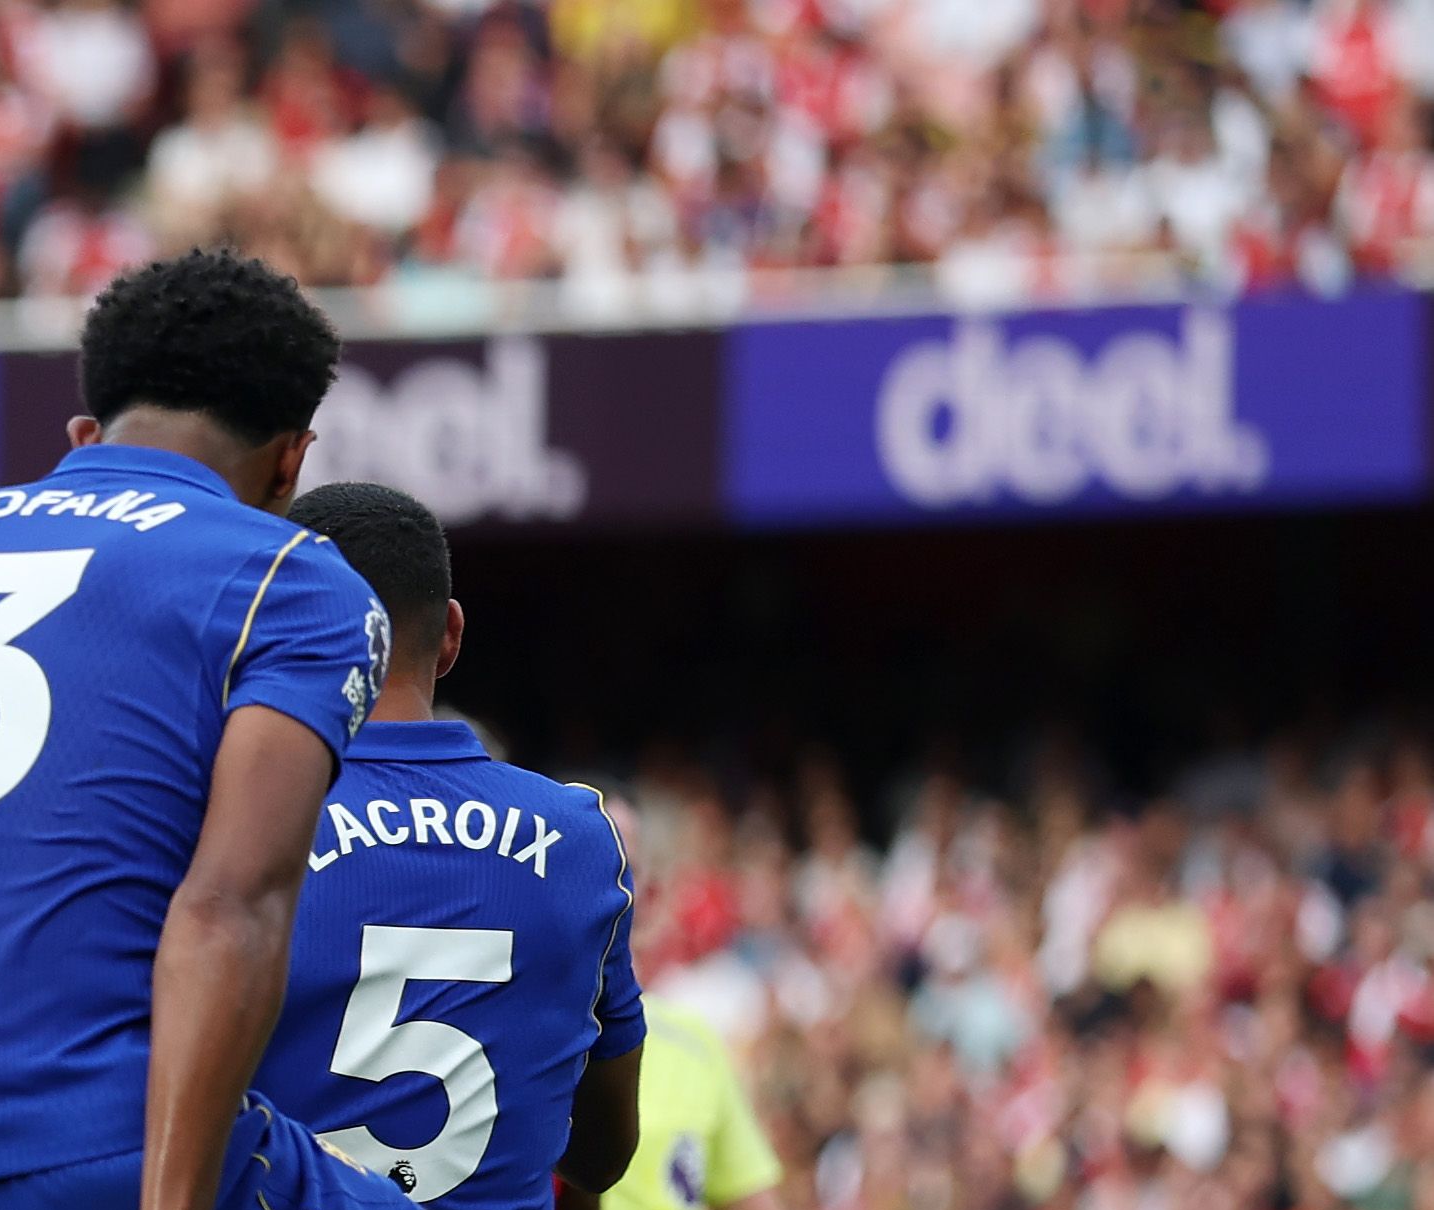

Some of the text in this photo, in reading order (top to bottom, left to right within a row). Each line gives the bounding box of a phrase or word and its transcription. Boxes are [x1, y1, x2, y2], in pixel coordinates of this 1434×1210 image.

[874, 303, 1272, 507] deel.
[308, 798, 562, 878] LACROIX
[316, 924, 514, 1202] 5
